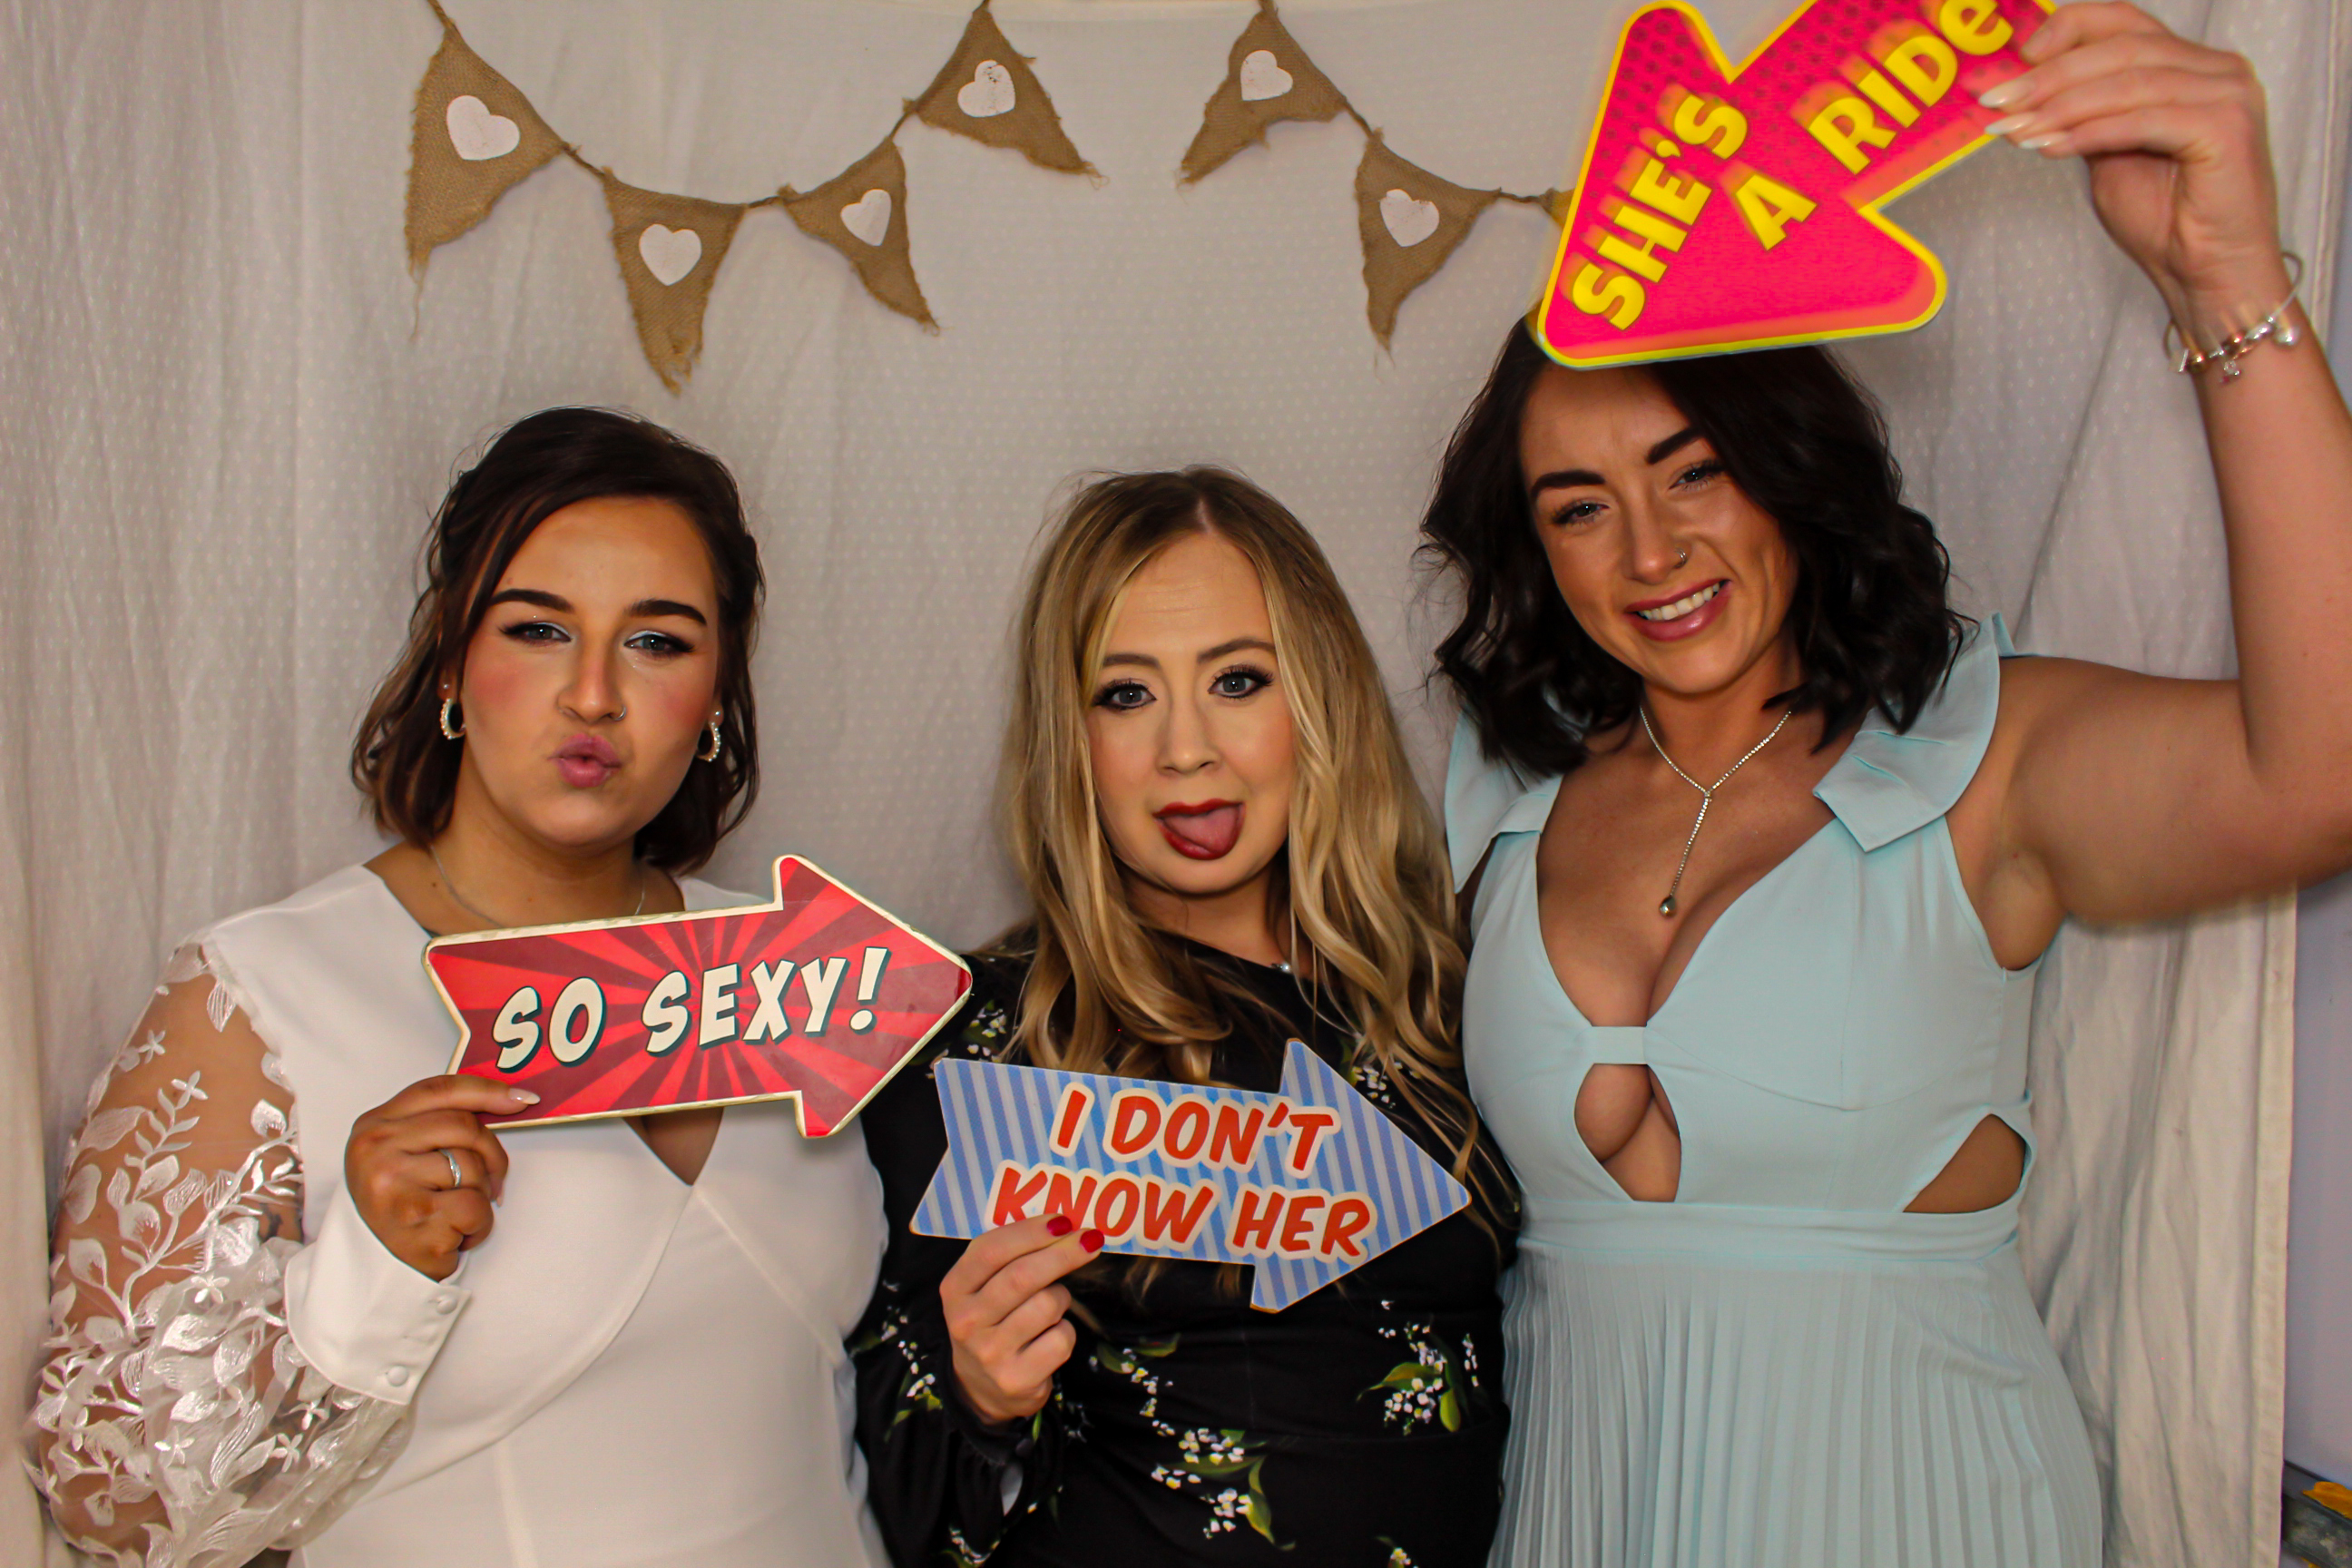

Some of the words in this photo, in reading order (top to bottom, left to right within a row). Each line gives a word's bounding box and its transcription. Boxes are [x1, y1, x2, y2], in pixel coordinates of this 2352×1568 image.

[1572, 93, 1748, 331] SHE'S
[1734, 173, 1818, 251] A
[493, 976, 606, 1072] SO
[642, 946, 888, 1055] SEXY!
[1056, 1089, 1087, 1150] I
[1110, 1094, 1334, 1171] DON'T
[992, 1167, 1214, 1244] KNOW
[1232, 1190, 1371, 1258] HER
